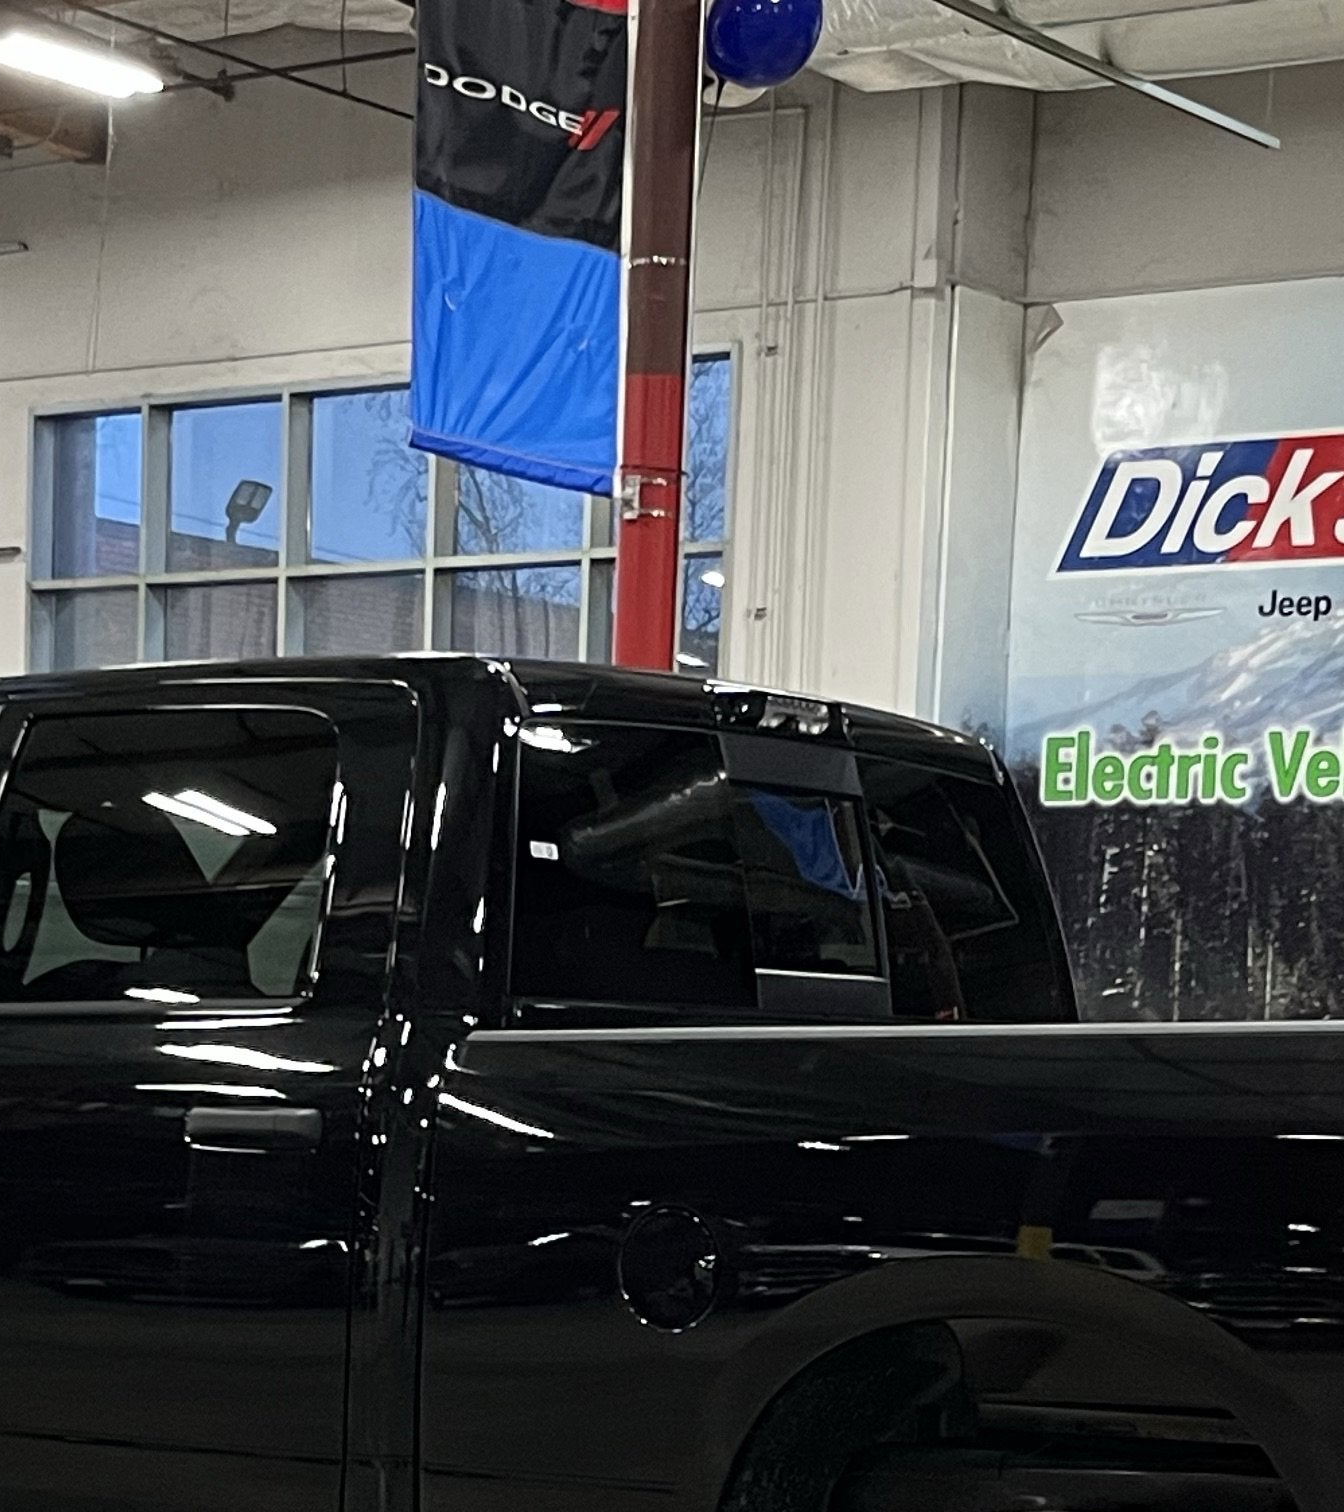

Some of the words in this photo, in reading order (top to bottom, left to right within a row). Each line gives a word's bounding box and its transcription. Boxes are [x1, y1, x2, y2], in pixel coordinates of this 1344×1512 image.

[425, 63, 586, 136] DODGE
[1258, 590, 1332, 621] Jeep
[1044, 731, 1249, 801] Electric
